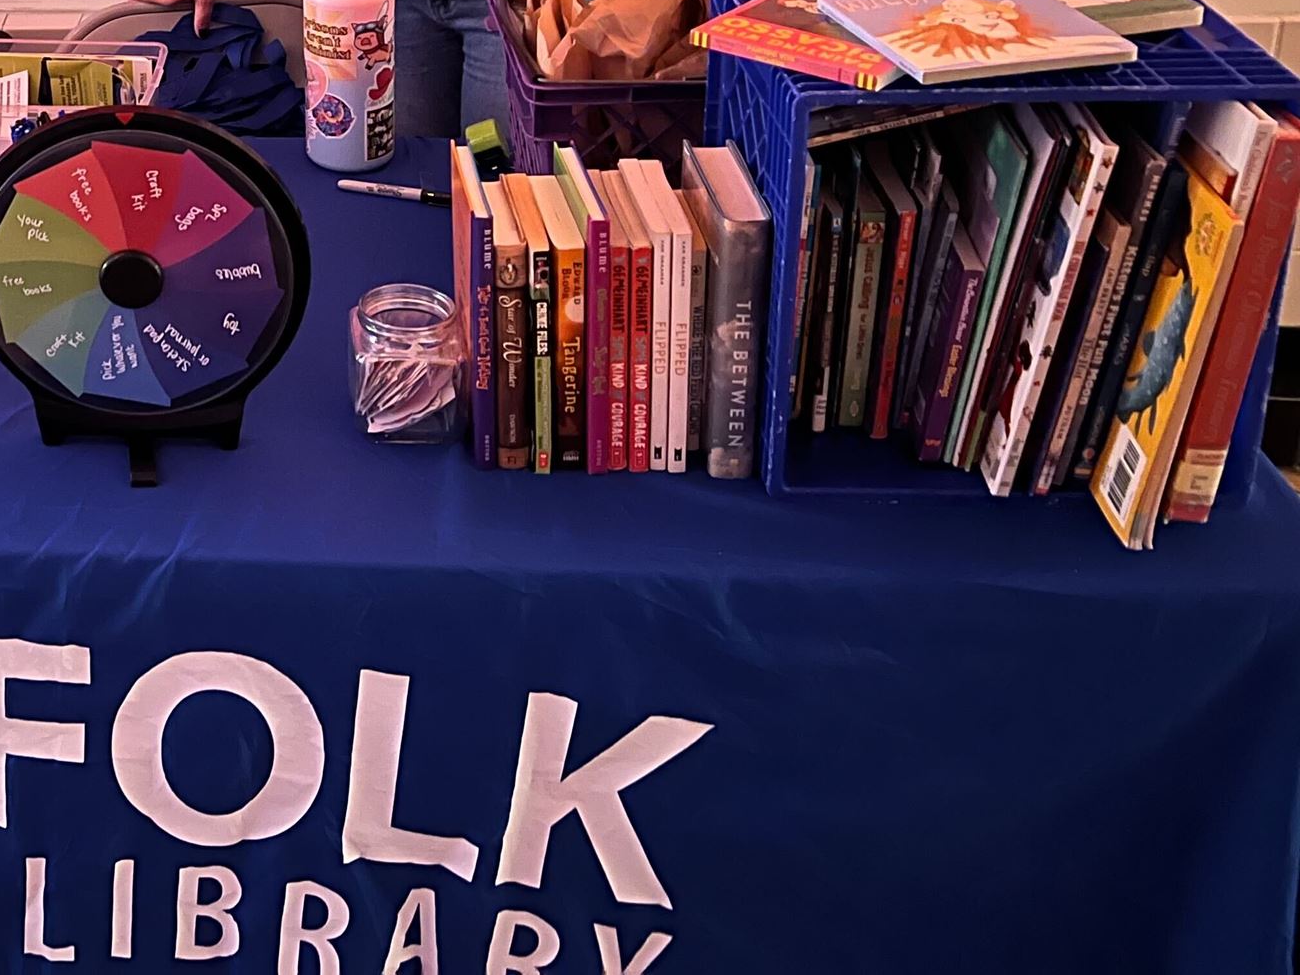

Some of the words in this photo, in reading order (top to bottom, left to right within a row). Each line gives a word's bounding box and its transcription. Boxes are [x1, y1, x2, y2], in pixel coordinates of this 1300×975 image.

[710, 24, 761, 42] WITH
[721, 16, 883, 63] PICASSO
[767, 38, 876, 70] PAINTING
[71, 167, 92, 196] free
[69, 189, 92, 222] books
[1139, 175, 1162, 222] HENKES
[175, 206, 203, 231] bags
[2, 276, 24, 287] free
[215, 263, 262, 279] bubbles
[573, 261, 583, 306] EDWARD
[1112, 245, 1139, 302] Kitten's
[22, 283, 52, 298] books
[612, 265, 629, 333] GEMEINHART
[635, 265, 649, 334] GEMEINHART
[858, 276, 874, 310] Calling
[222, 312, 241, 336] toy
[498, 295, 522, 322] Star
[693, 305, 704, 339] WHERE
[733, 300, 752, 341] THE
[1100, 304, 1120, 338] First
[164, 323, 202, 358] journal
[507, 324, 518, 335] of
[535, 330, 549, 356] FILES:
[127, 343, 139, 369] want
[198, 353, 210, 366] or
[501, 336, 523, 389] Wonder
[654, 321, 667, 375] FLIPPED
[675, 322, 687, 376] FLIPPED
[692, 339, 703, 359] THE
[1082, 336, 1095, 358] The
[1092, 339, 1109, 365] Full
[562, 336, 581, 414] Tangerine
[611, 362, 625, 388] KIND
[634, 363, 647, 390] KIND
[939, 366, 957, 398] Blessings
[1078, 367, 1101, 406] Moon
[727, 350, 749, 448] BETWEEN
[611, 402, 624, 447] COURAGE
[633, 403, 647, 449] COURAGE
[24, 856, 674, 975] LIBRARY
